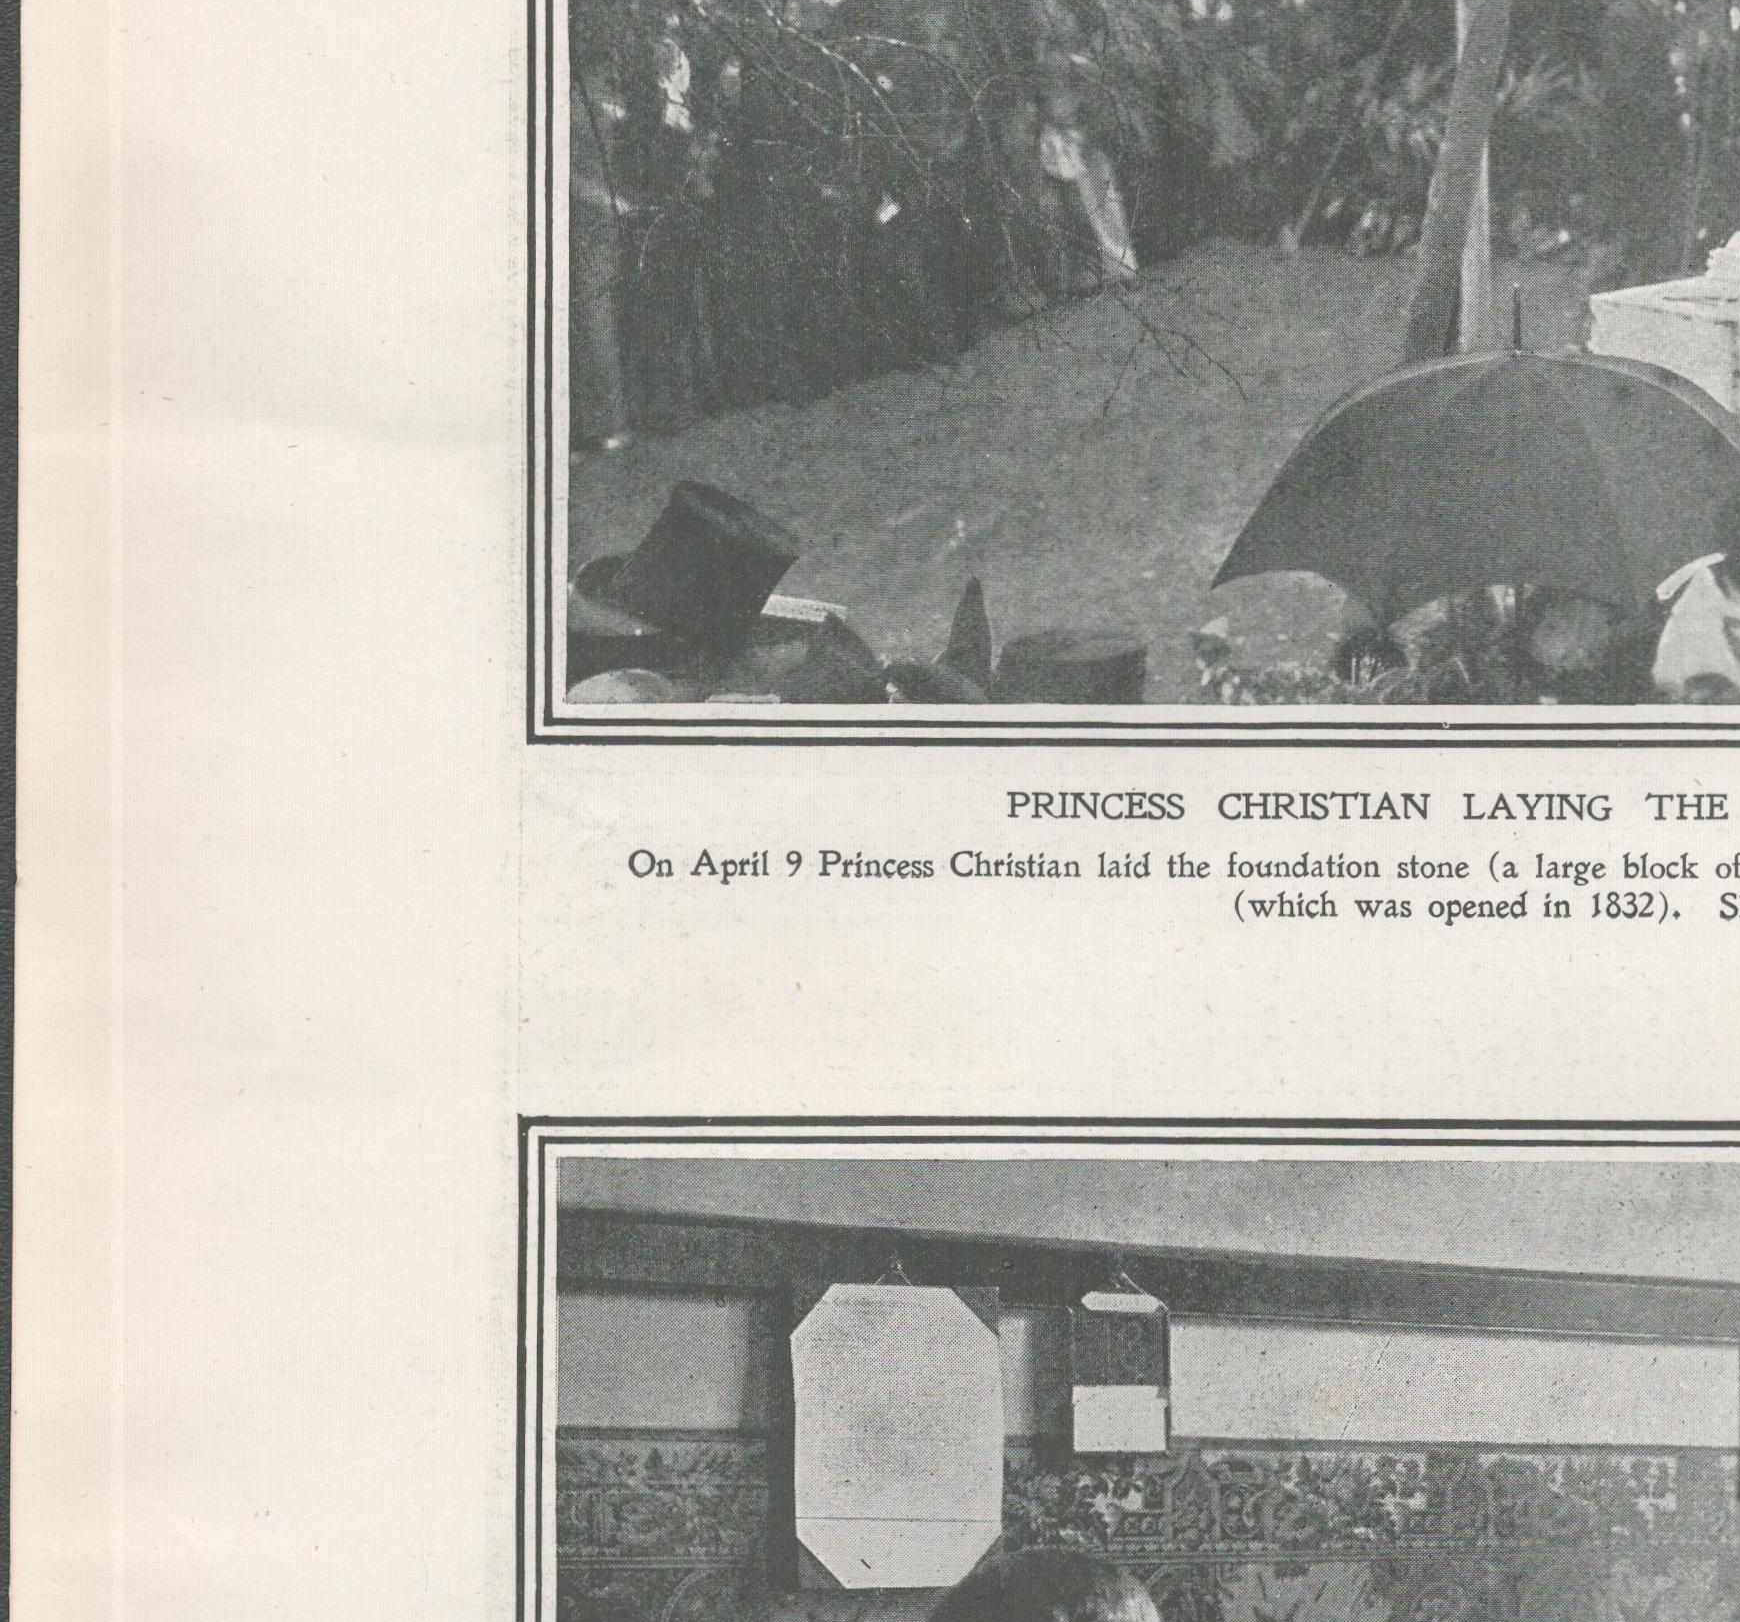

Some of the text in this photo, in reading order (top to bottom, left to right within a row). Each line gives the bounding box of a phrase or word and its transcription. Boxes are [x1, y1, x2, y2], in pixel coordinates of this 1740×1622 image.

[1006, 791, 1185, 821] PRINCESS
[1217, 791, 1431, 821] CHRISTIAN
[1462, 792, 1613, 822] LAYING
[1645, 792, 1729, 821] THE
[628, 849, 674, 878] On
[690, 848, 770, 886] April
[786, 850, 803, 877] 9
[818, 849, 935, 879] Princess
[950, 850, 1081, 879] Christian
[1098, 851, 1151, 879] laid
[1167, 851, 1211, 879] the
[1227, 851, 1381, 879] foundation
[1397, 854, 1470, 879] stone
[1489, 851, 1519, 883] (a
[1535, 853, 1606, 887] large
[1622, 852, 1699, 879] block
[1234, 889, 1338, 923] (which
[1354, 899, 1412, 918] was
[1428, 890, 1528, 927] opened
[1543, 892, 1572, 919] in
[1591, 891, 1681, 924] 1832).
